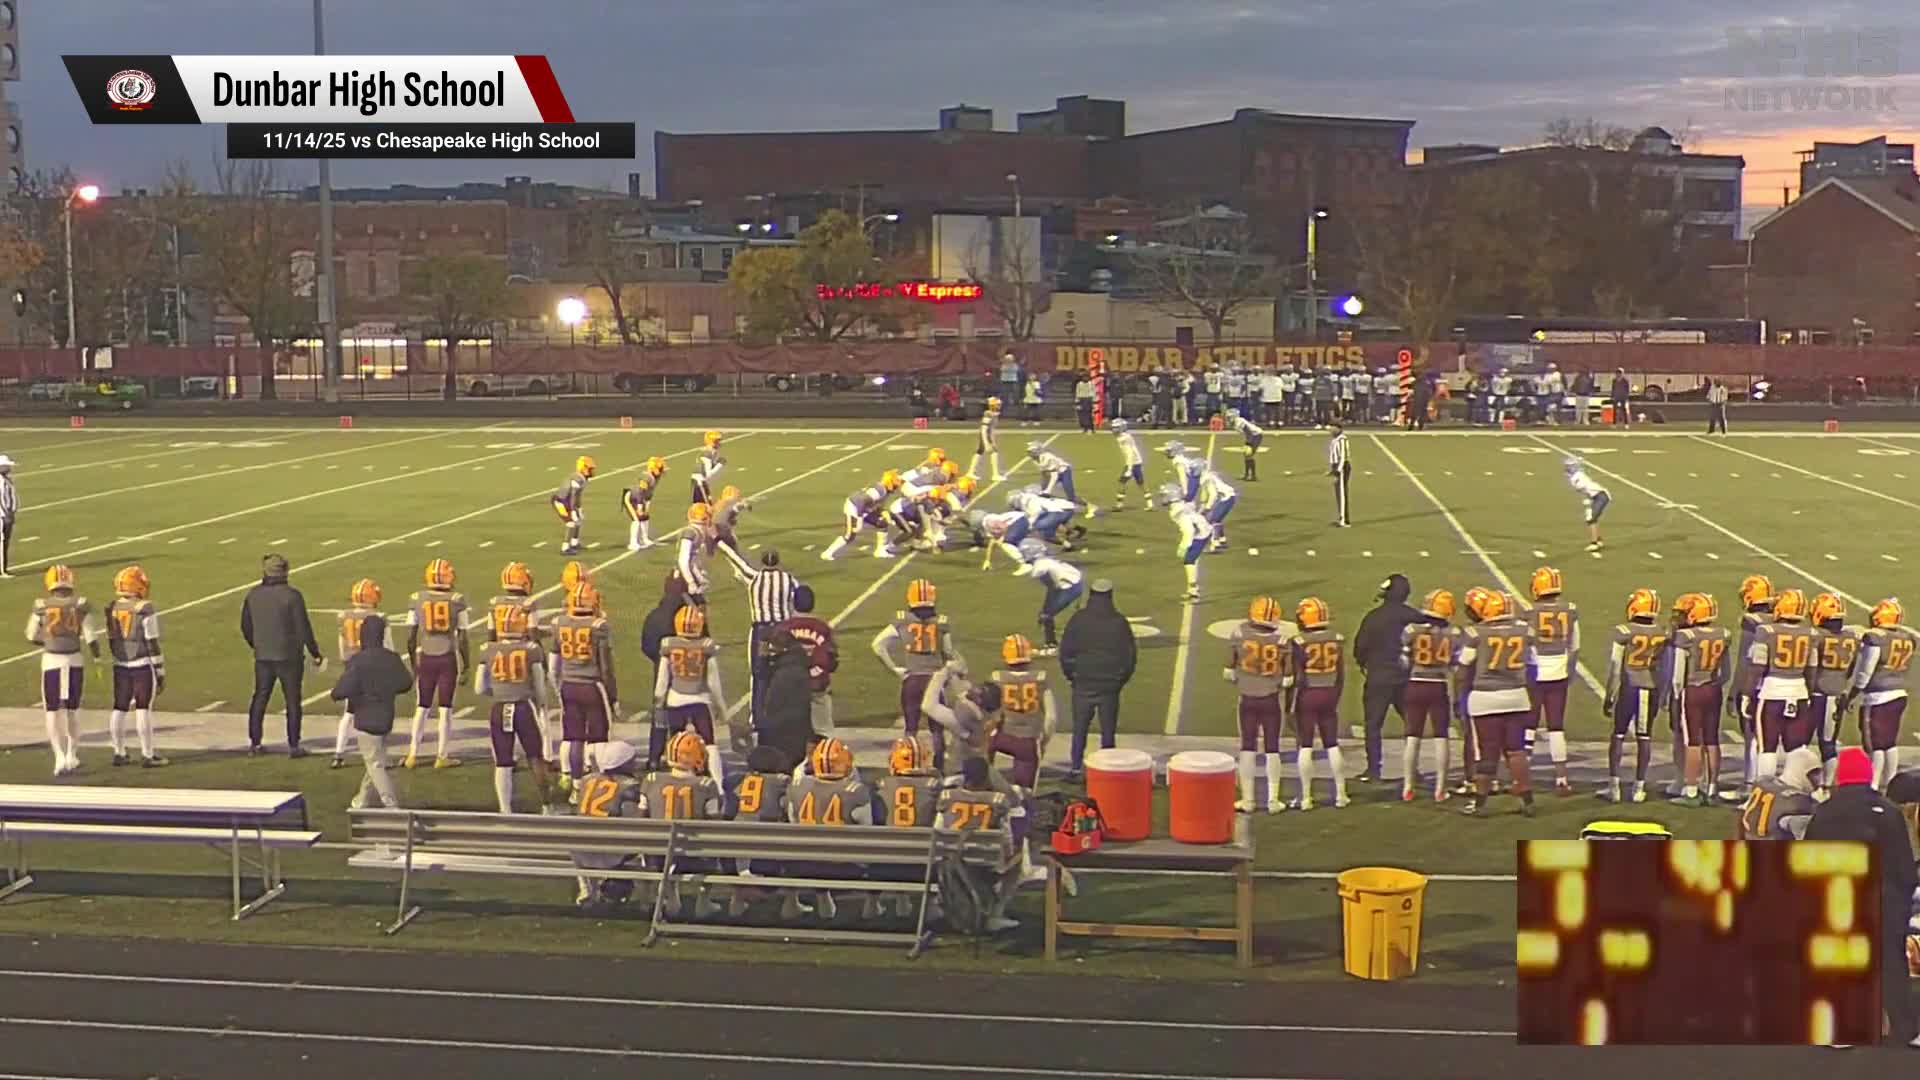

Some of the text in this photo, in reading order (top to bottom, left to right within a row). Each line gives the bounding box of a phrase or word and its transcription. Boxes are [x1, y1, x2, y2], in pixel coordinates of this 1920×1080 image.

[917, 282, 982, 300] Express
[1194, 345, 1364, 371] ATHLETICS
[46, 606, 80, 640] 24
[114, 609, 134, 639] 7
[421, 600, 450, 632] 19
[1538, 610, 1569, 643] 51
[559, 626, 594, 661] 88
[905, 622, 939, 653] 31
[1414, 633, 1451, 666] 84
[1486, 635, 1526, 670] 72
[1774, 634, 1810, 669] 50
[1822, 637, 1857, 669] 53
[1886, 638, 1914, 671] 62
[491, 649, 528, 683] 40
[1240, 640, 1280, 677] 28
[1304, 641, 1338, 675] 26
[1002, 681, 1040, 713] 58
[579, 777, 620, 817] 12
[661, 784, 694, 821] 11
[739, 774, 765, 814] 9
[798, 791, 844, 825] 44
[893, 785, 917, 827] 8
[950, 800, 993, 832] 27
